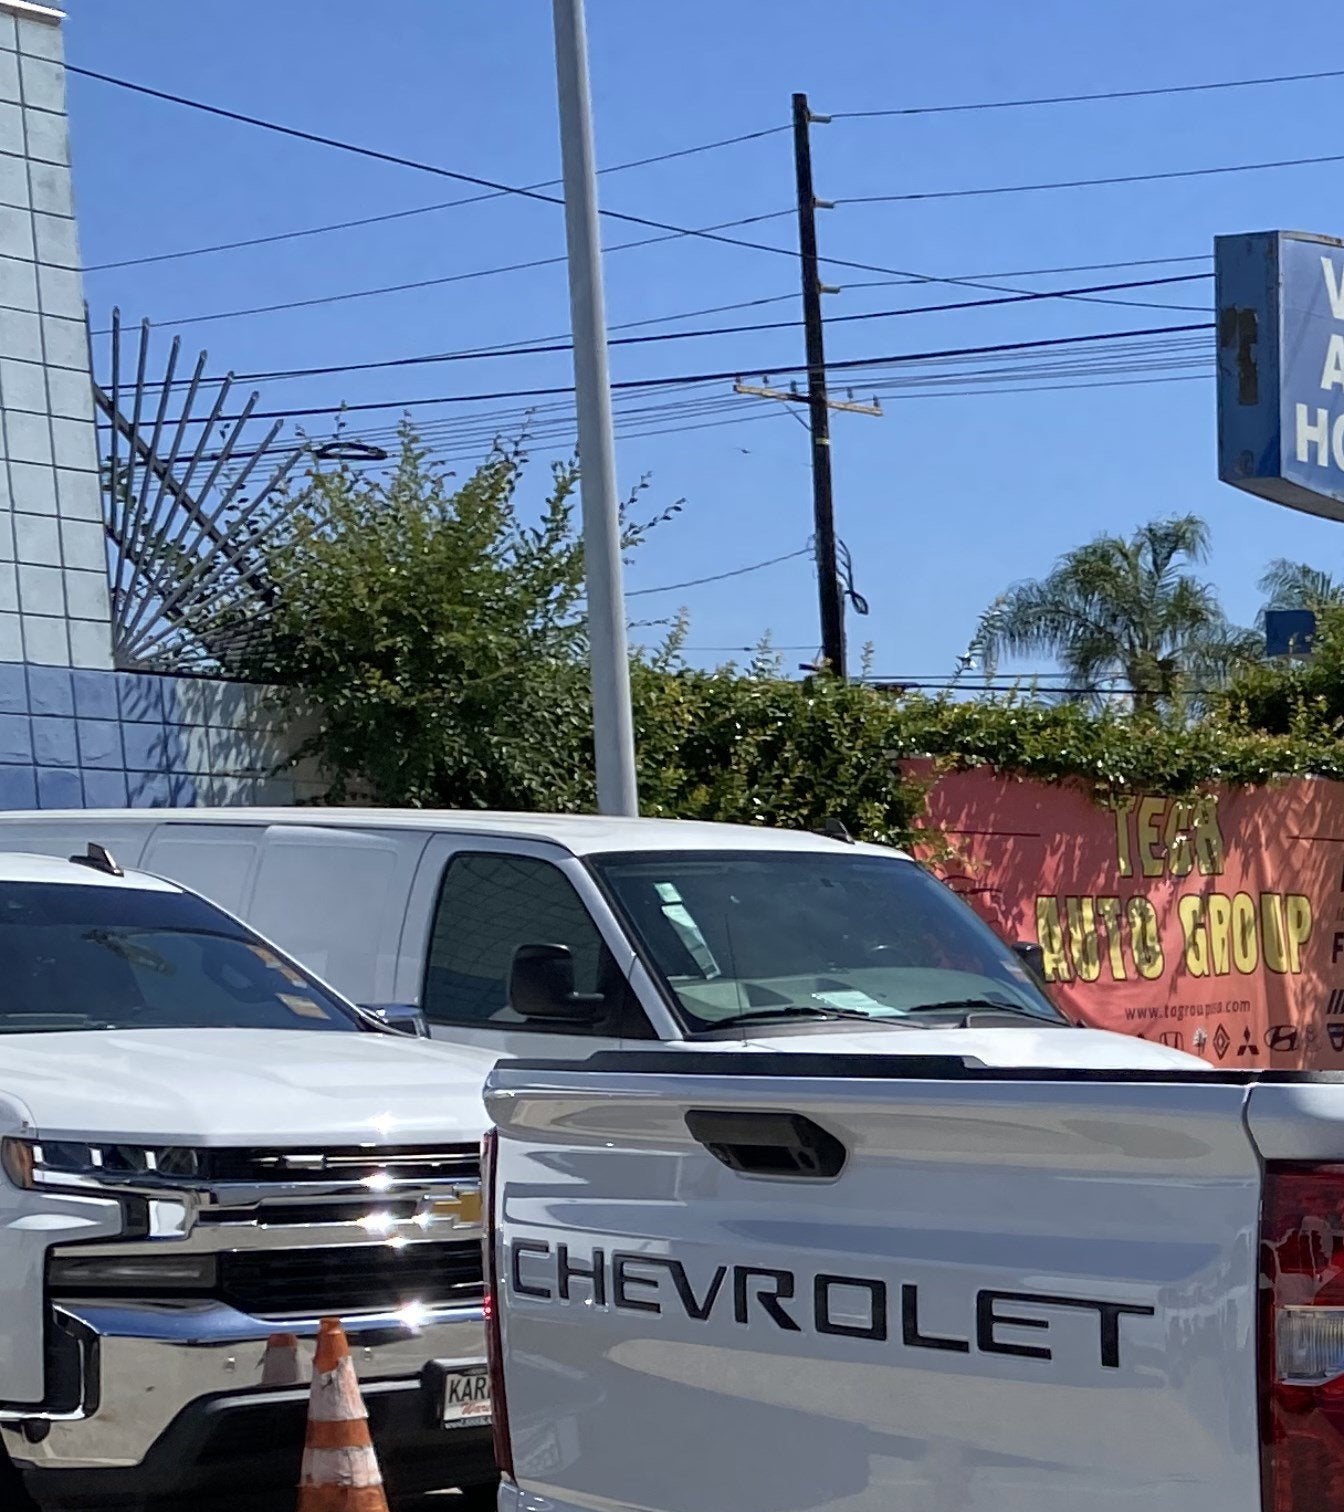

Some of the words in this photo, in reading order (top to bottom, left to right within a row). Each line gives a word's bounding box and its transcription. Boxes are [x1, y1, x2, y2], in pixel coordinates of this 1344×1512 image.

[1035, 894, 1165, 982] AUTO
[1178, 891, 1313, 978] GROUP
[510, 1237, 1156, 1368] CHEVROLET
[449, 1377, 491, 1403] KAR
